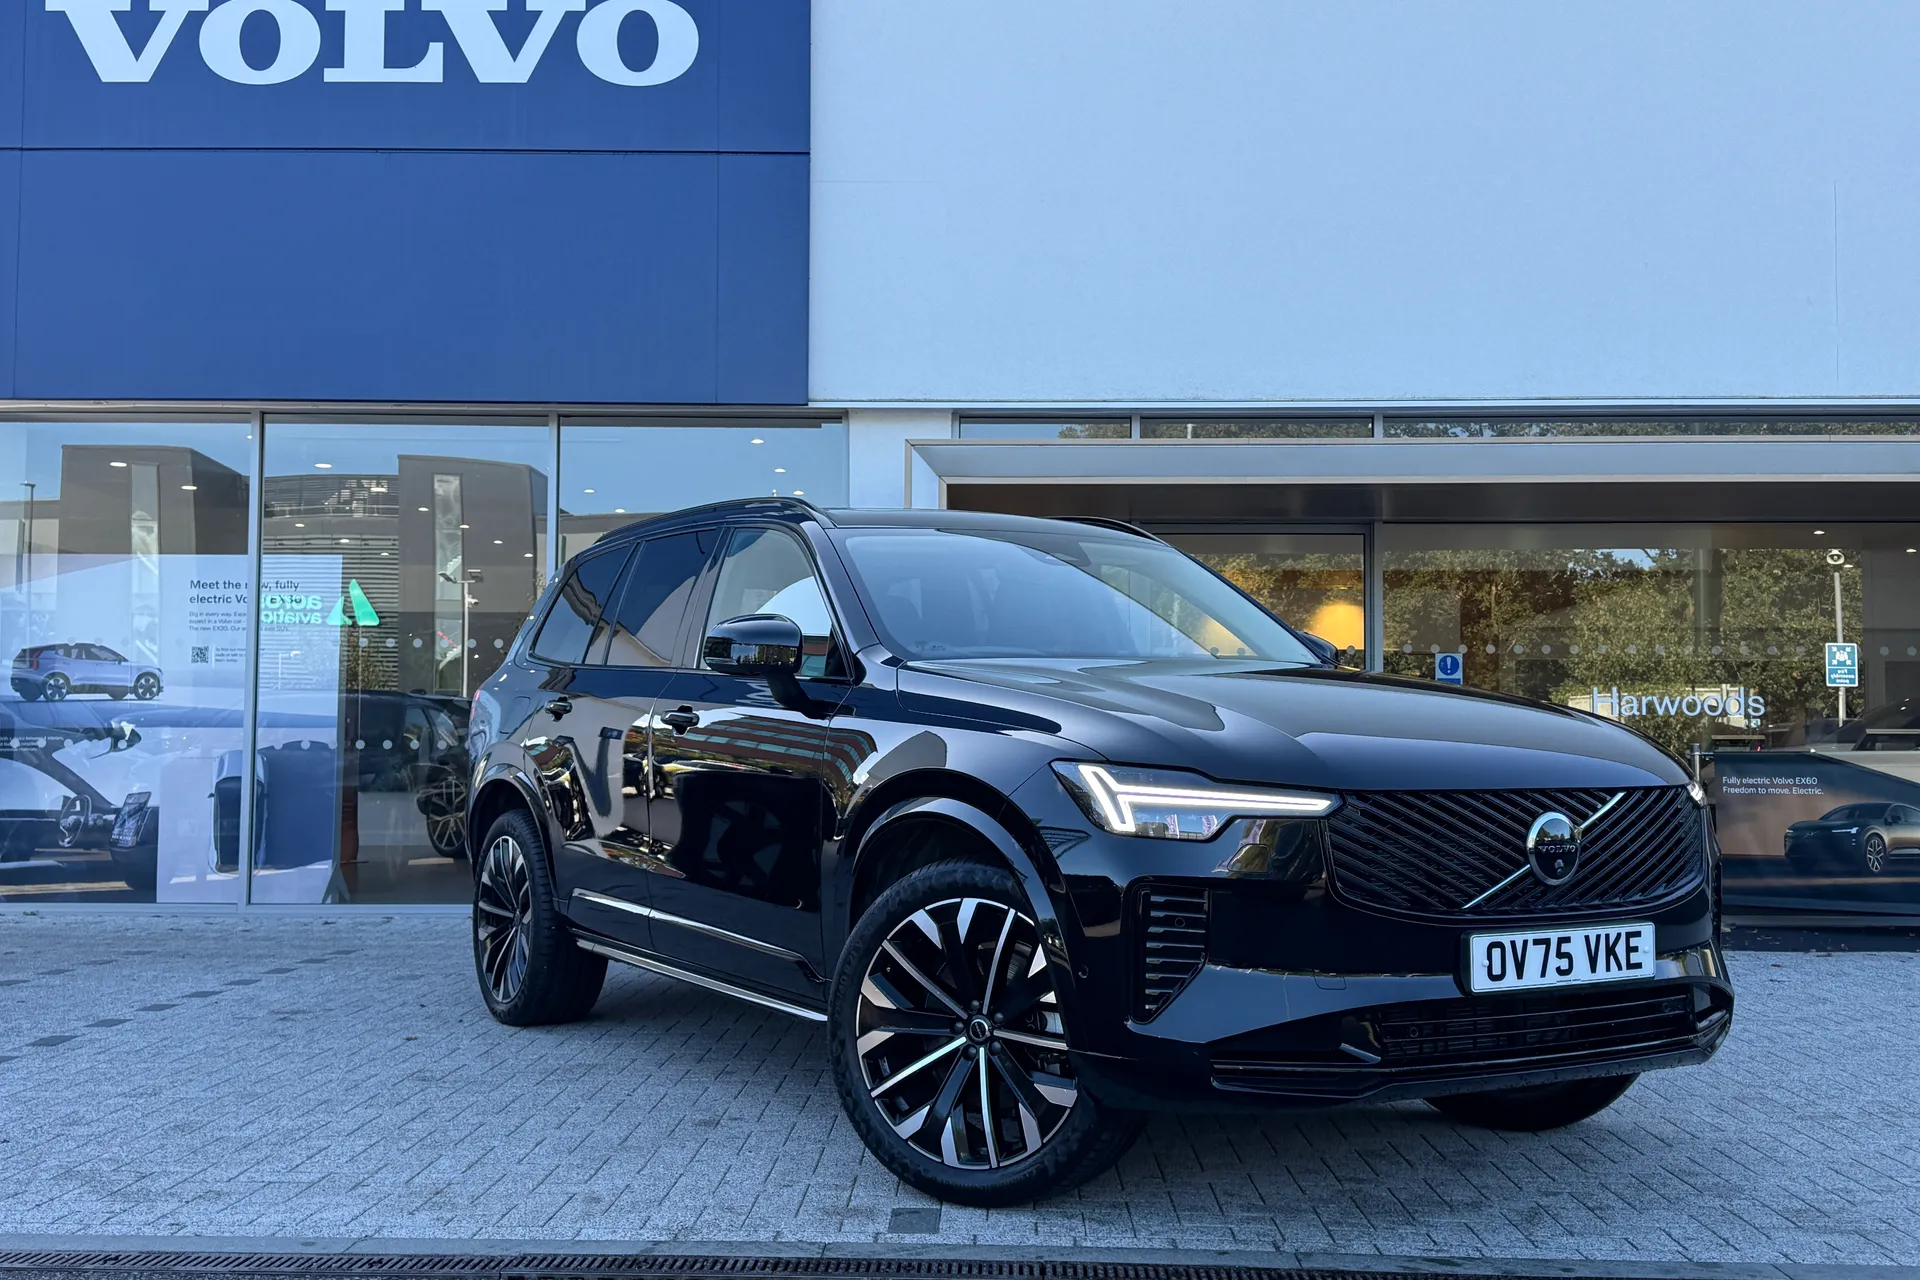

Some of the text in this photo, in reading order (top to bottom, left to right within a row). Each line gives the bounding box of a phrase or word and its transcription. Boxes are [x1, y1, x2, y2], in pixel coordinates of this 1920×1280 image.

[45, 0, 699, 86] VOLVO
[190, 580, 220, 590] Meet
[223, 580, 242, 590] the
[275, 580, 300, 592] fully
[190, 594, 233, 604] electric
[1593, 686, 1766, 717] Harwoods
[1722, 776, 1818, 786] Fully electric Volvo EX60
[1722, 786, 1757, 794] Freedom
[1792, 786, 1824, 795] Electric.
[1537, 844, 1576, 853] VOLVO
[1486, 930, 1643, 982] OV75 VKE
